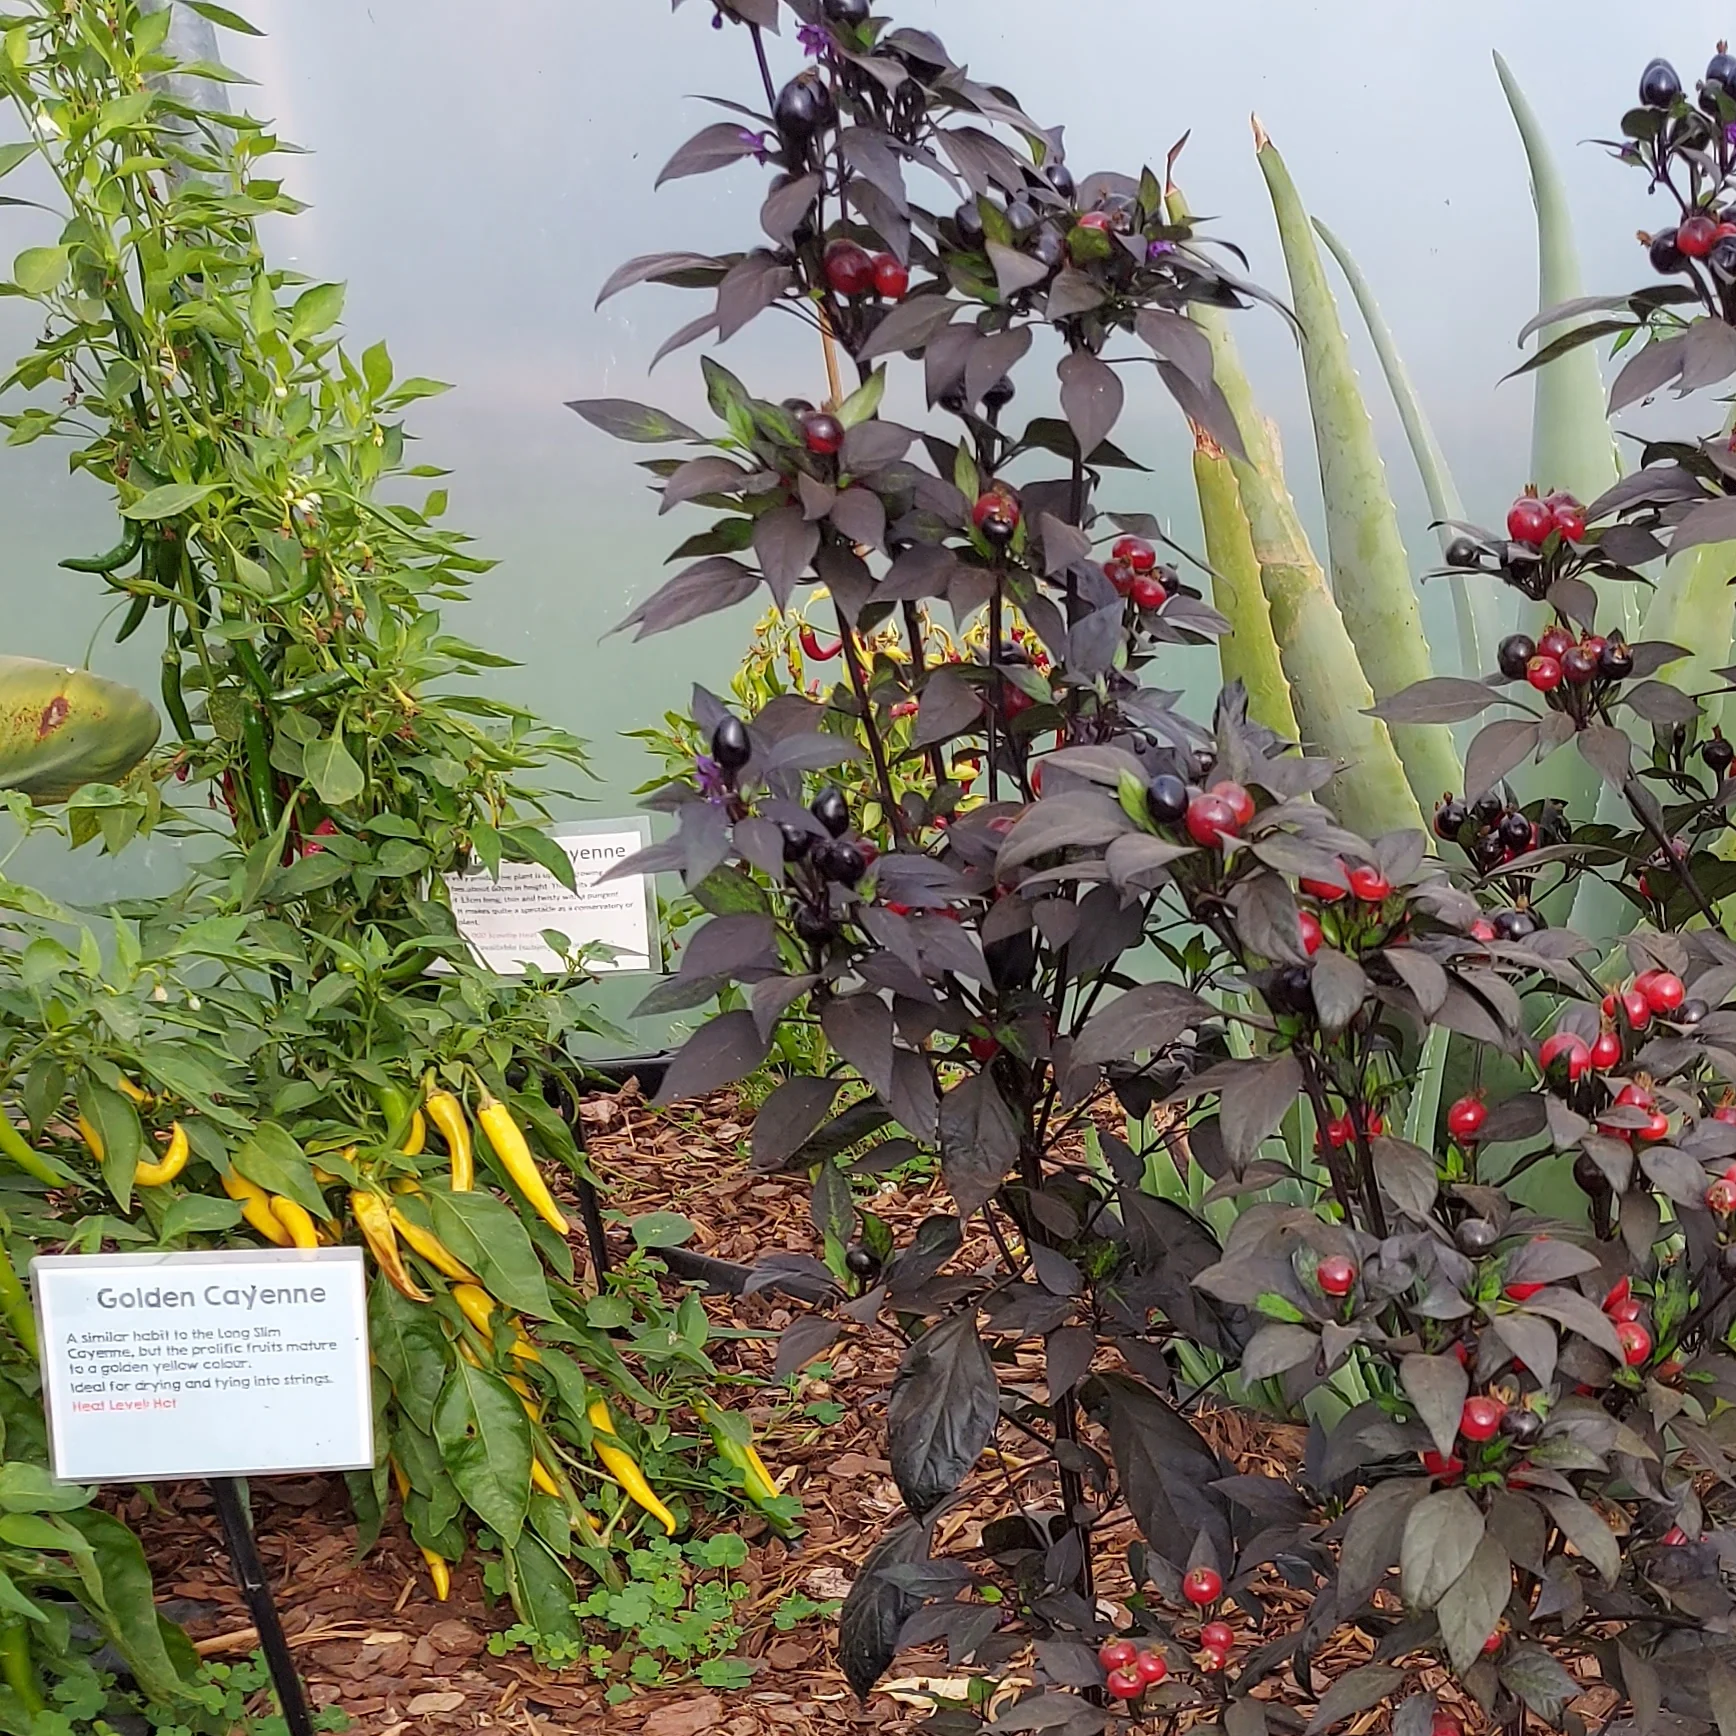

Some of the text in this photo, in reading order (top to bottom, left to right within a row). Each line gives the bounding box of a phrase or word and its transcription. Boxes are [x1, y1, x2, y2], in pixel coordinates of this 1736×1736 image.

[570, 846, 626, 864] yenne
[97, 1285, 326, 1310] Golden Cayenne
[66, 1326, 281, 1344] A similar habit to the Long Slim
[139, 1346, 161, 1357] but
[166, 1345, 188, 1356] the
[192, 1343, 242, 1358] prolific
[247, 1341, 283, 1353] fruits
[286, 1340, 337, 1352] mature
[69, 1358, 252, 1376] to a golden yellow colour.
[70, 1373, 334, 1393] Ideal for drying and tying into strings.
[72, 1398, 176, 1412] Heat Level: Hot
